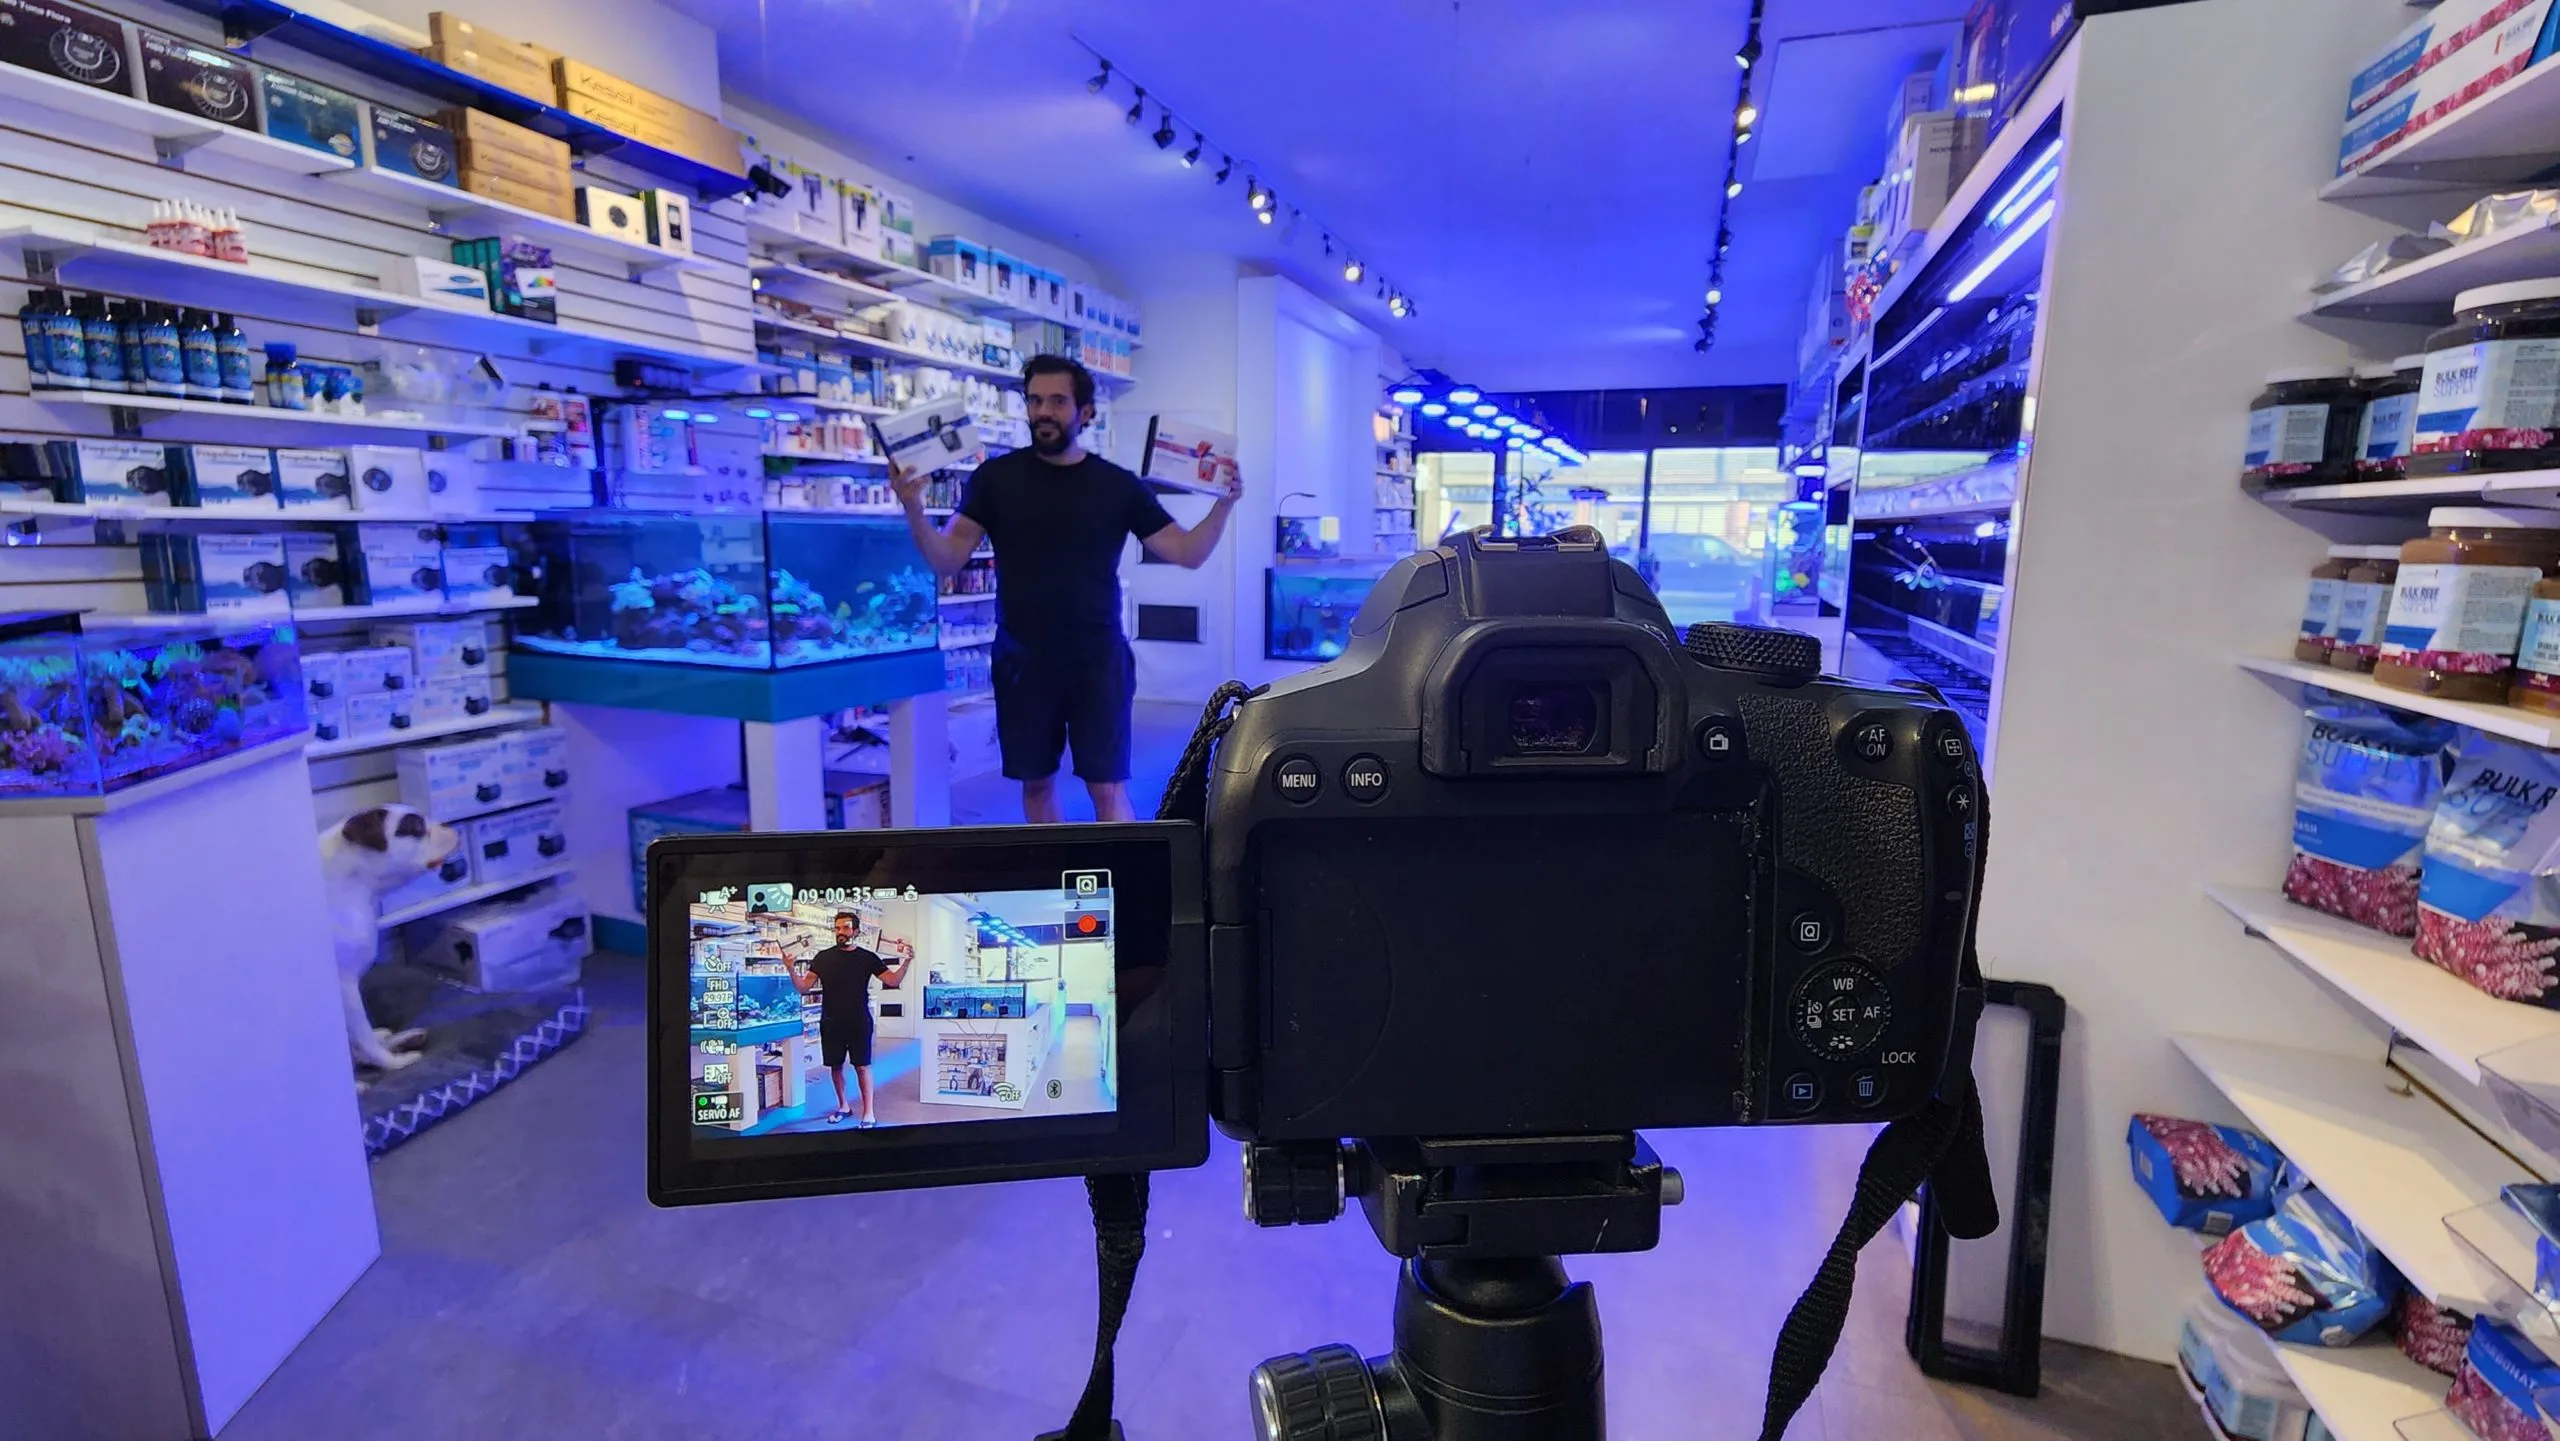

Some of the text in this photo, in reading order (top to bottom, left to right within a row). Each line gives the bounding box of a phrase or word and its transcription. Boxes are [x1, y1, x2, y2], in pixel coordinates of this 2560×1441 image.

[1868, 728, 1886, 742] AF
[1866, 743, 1887, 757] ON
[1282, 774, 1316, 788] MENU
[1350, 773, 1383, 787] INFO
[2471, 767, 2540, 805] BULK
[1080, 879, 1093, 892] Q
[798, 886, 872, 905] 09:00:35
[1804, 924, 1817, 938] Q
[715, 960, 733, 973] OFF
[710, 979, 729, 991] FHD
[1832, 977, 1854, 991] WB
[1832, 1008, 1856, 1022] SET
[1863, 1006, 1881, 1019] AF
[717, 1018, 733, 1030] OFF
[1881, 1051, 1916, 1064] LOCK
[717, 1072, 733, 1084] OFF
[1005, 1090, 1020, 1101] OFF
[697, 1107, 741, 1121] SERVO AF
